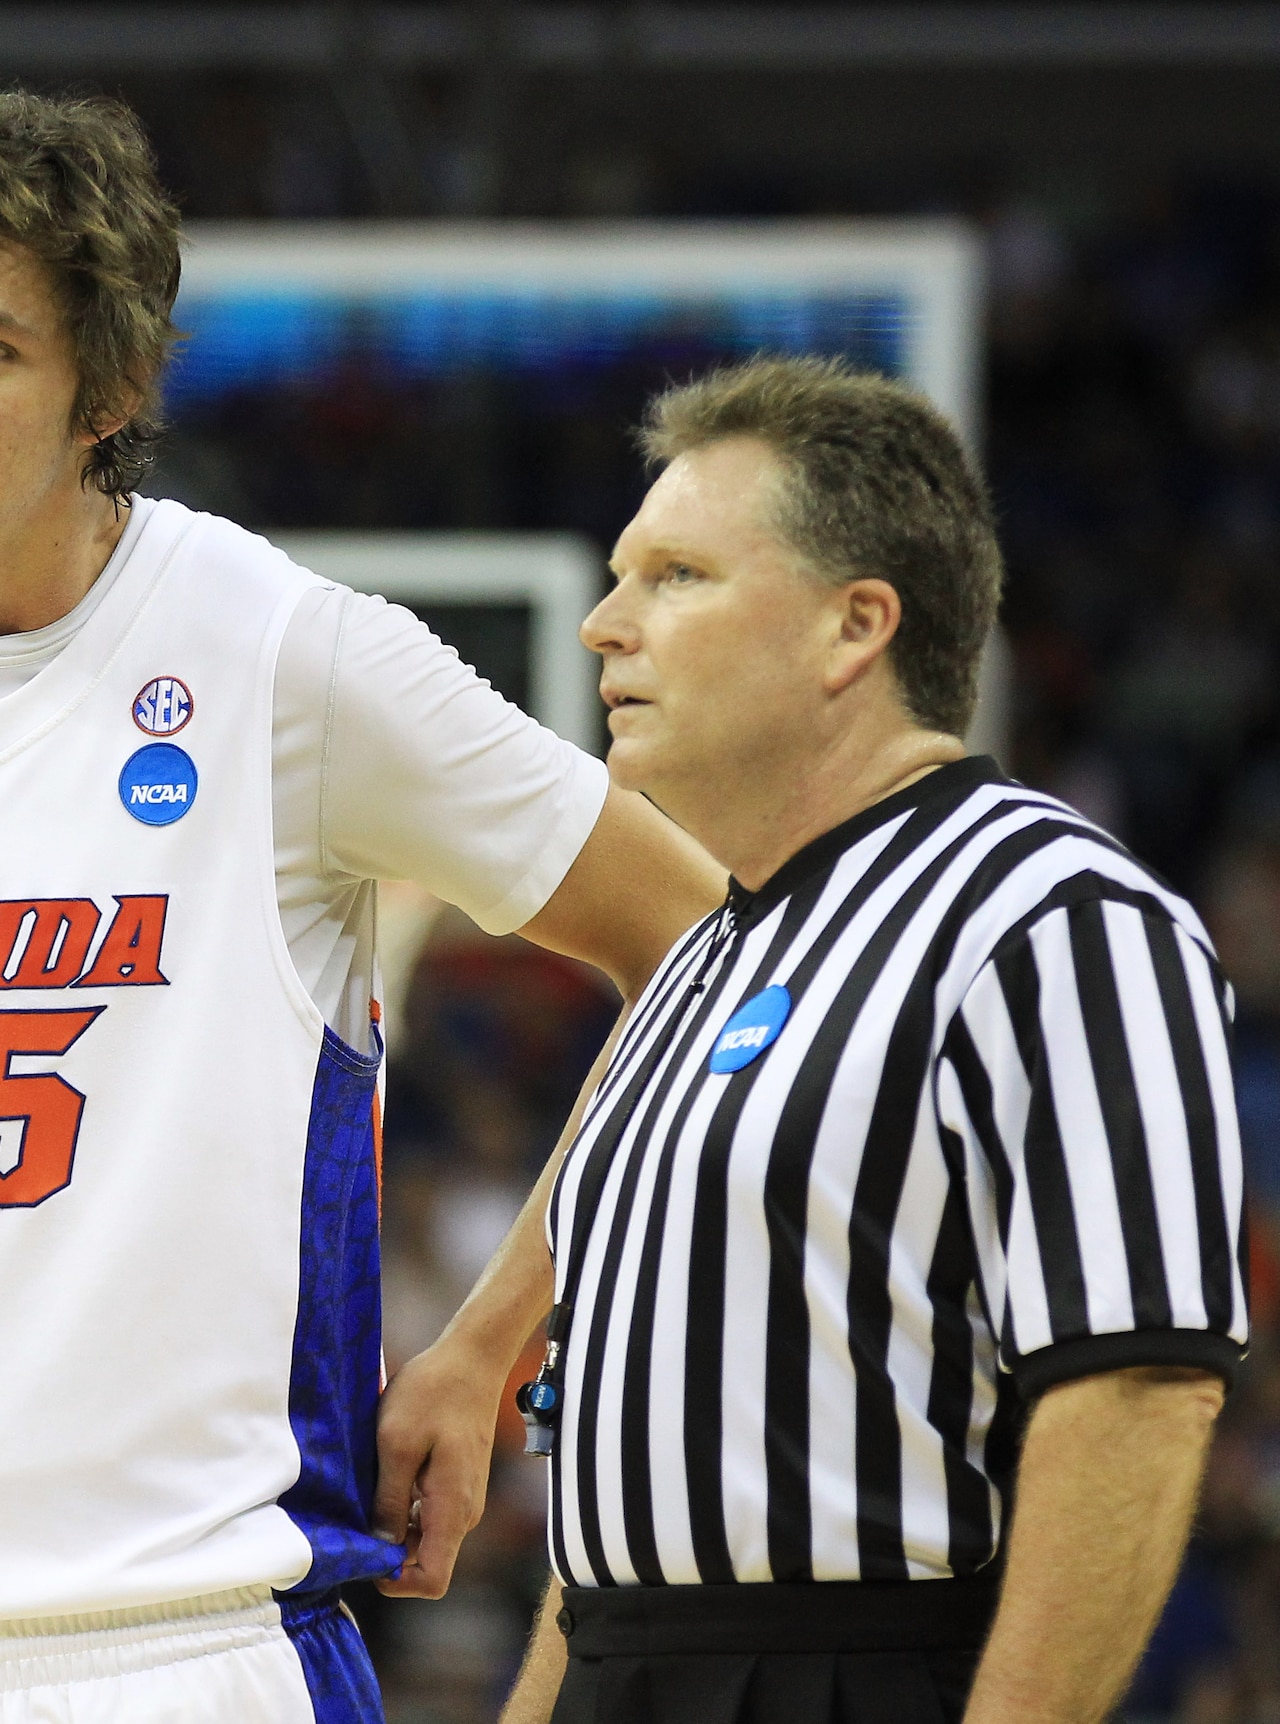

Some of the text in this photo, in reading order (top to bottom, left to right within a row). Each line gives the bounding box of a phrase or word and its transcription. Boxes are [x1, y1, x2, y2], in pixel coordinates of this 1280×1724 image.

[137, 679, 188, 731] SEC
[130, 784, 187, 804] NCAA
[716, 1026, 769, 1054] NCAA
